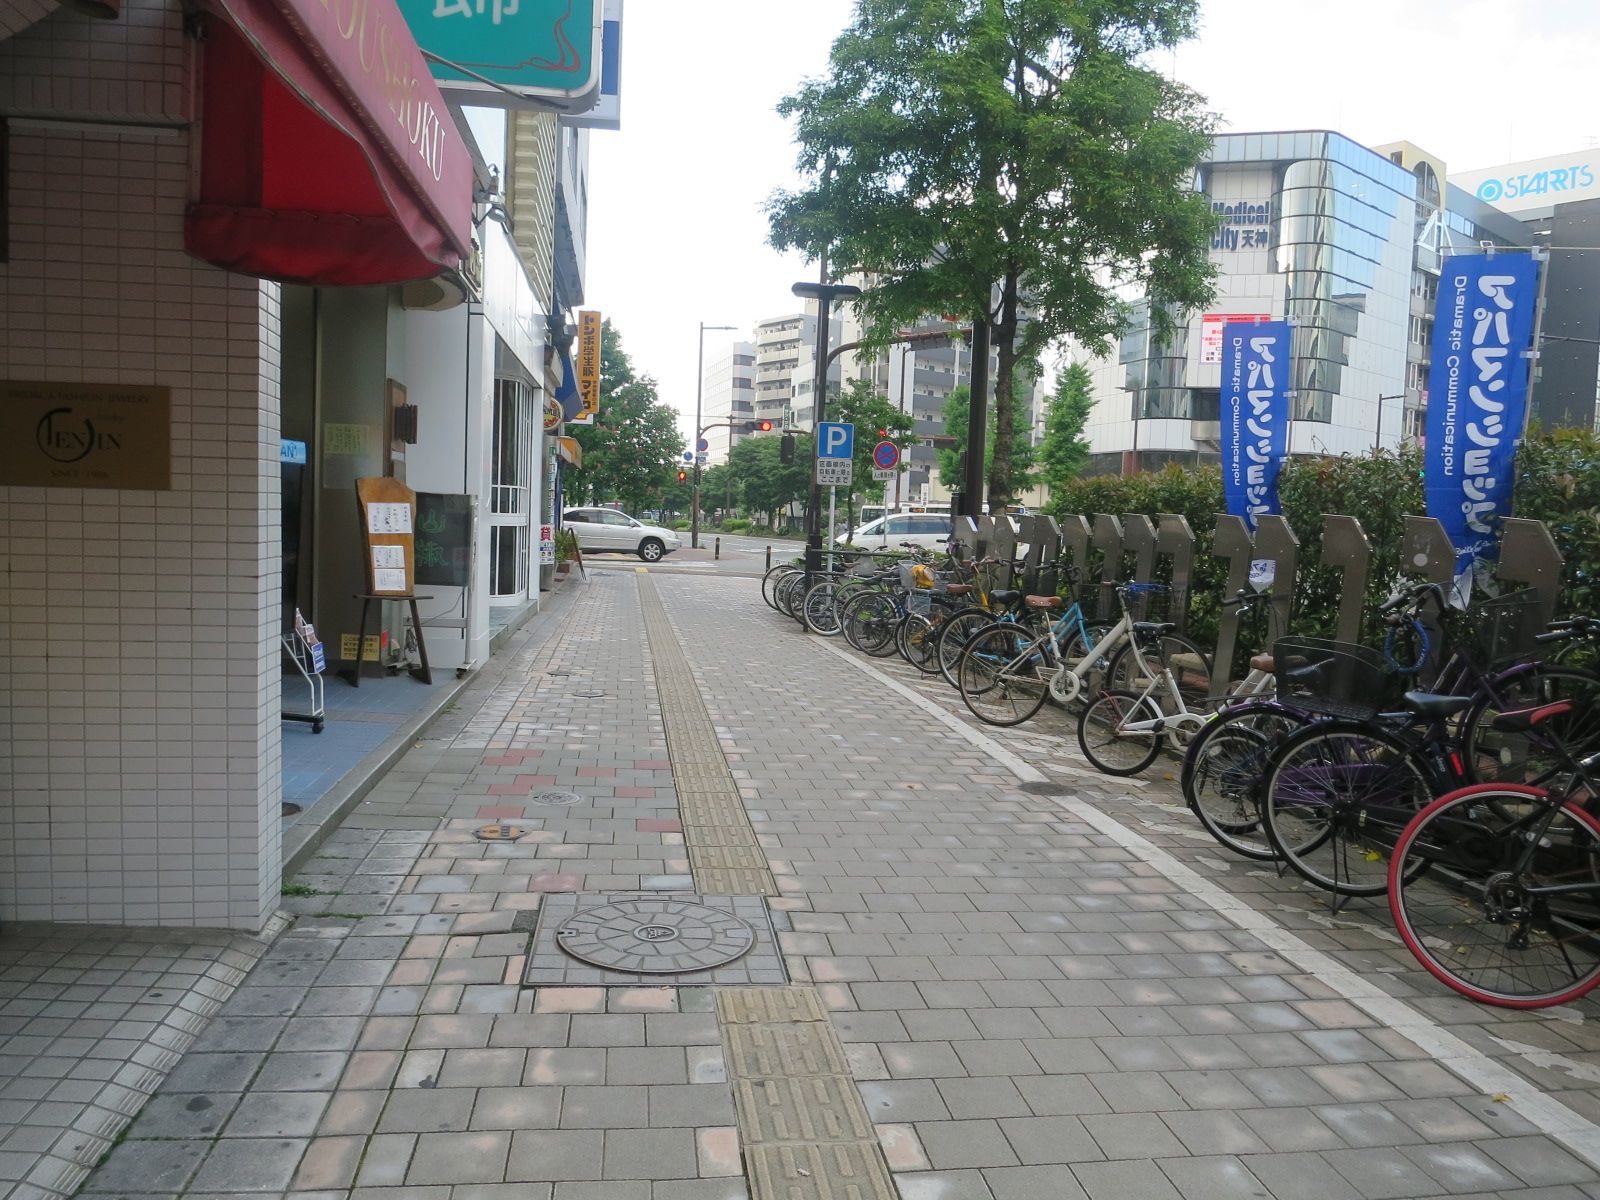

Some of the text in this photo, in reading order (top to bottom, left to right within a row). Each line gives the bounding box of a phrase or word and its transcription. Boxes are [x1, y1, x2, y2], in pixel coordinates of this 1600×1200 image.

[320, 0, 446, 182] OUSHOKU
[1504, 164, 1595, 199] STARTS
[1212, 201, 1270, 225] Medical
[1210, 227, 1268, 251] City 天神
[827, 426, 847, 455] P
[820, 476, 849, 484] ここまで
